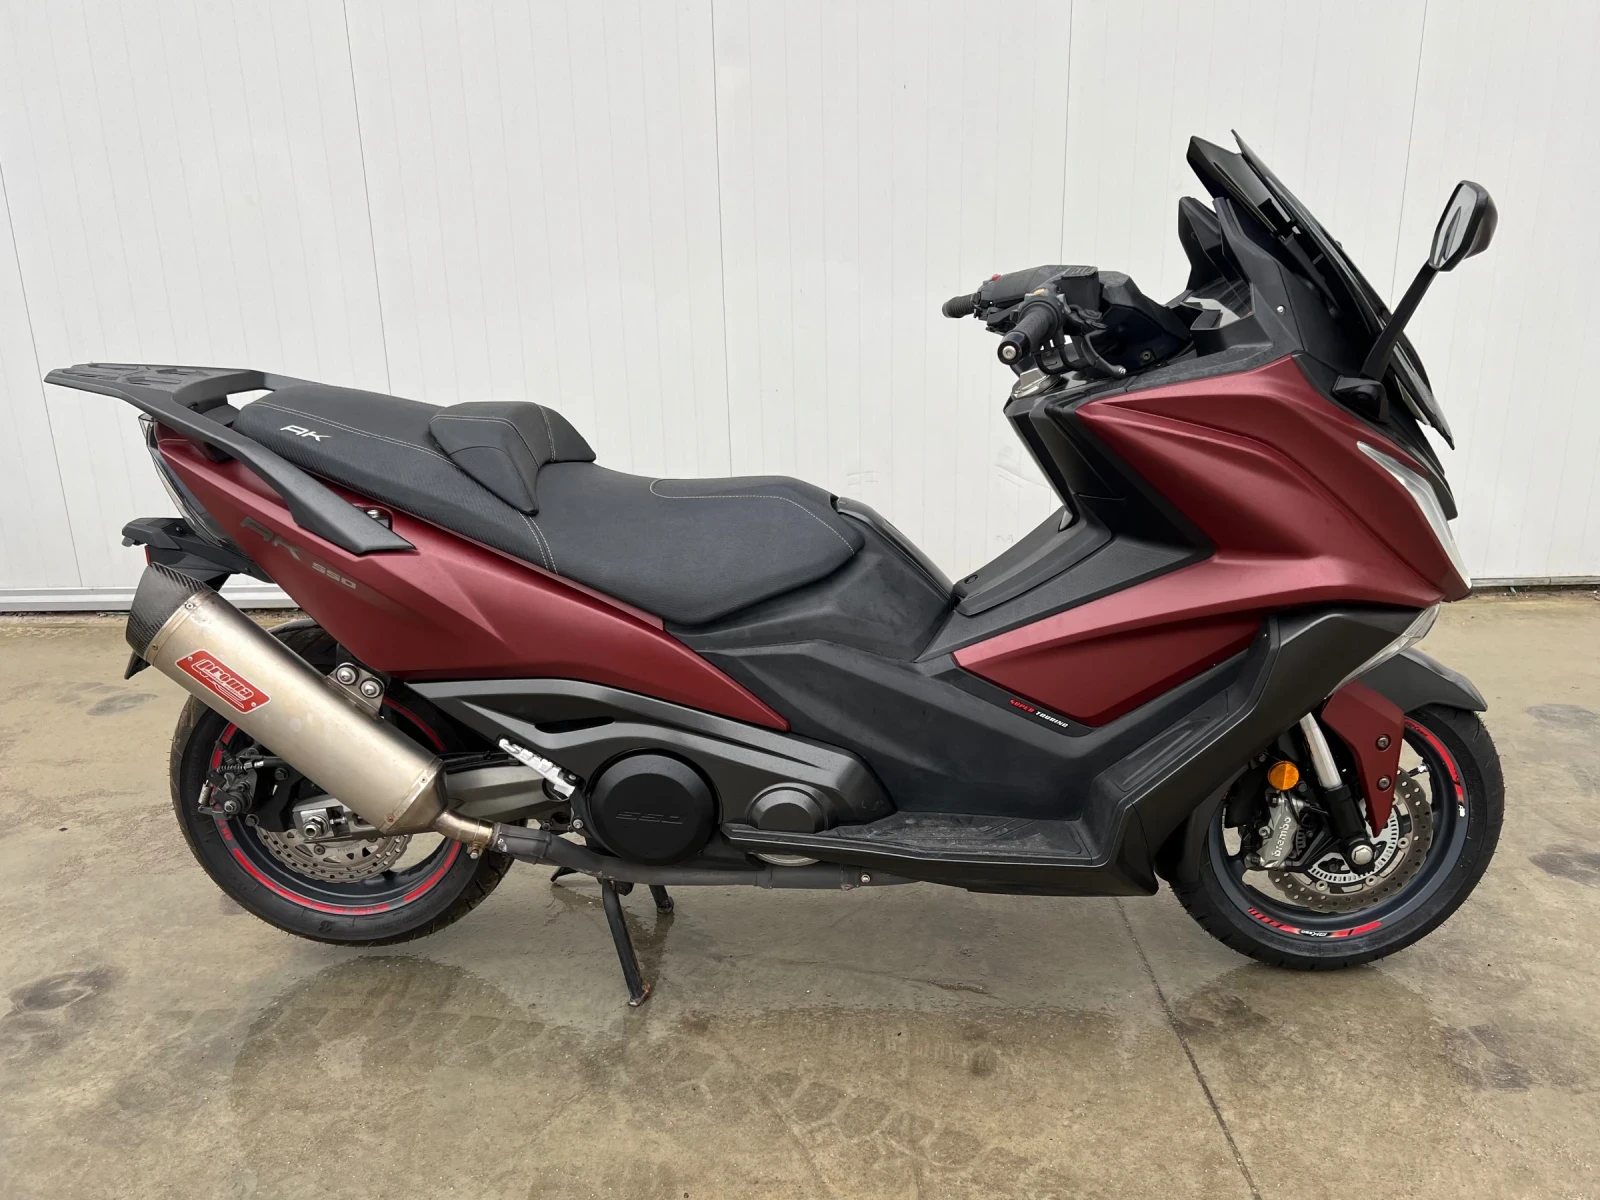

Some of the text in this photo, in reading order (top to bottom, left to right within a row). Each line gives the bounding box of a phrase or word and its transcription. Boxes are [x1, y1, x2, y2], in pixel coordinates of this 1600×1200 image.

[280, 424, 332, 442] AK
[240, 516, 357, 590] AK 550
[1010, 699, 1035, 713] SUPER
[1271, 816, 1292, 857] brembo
